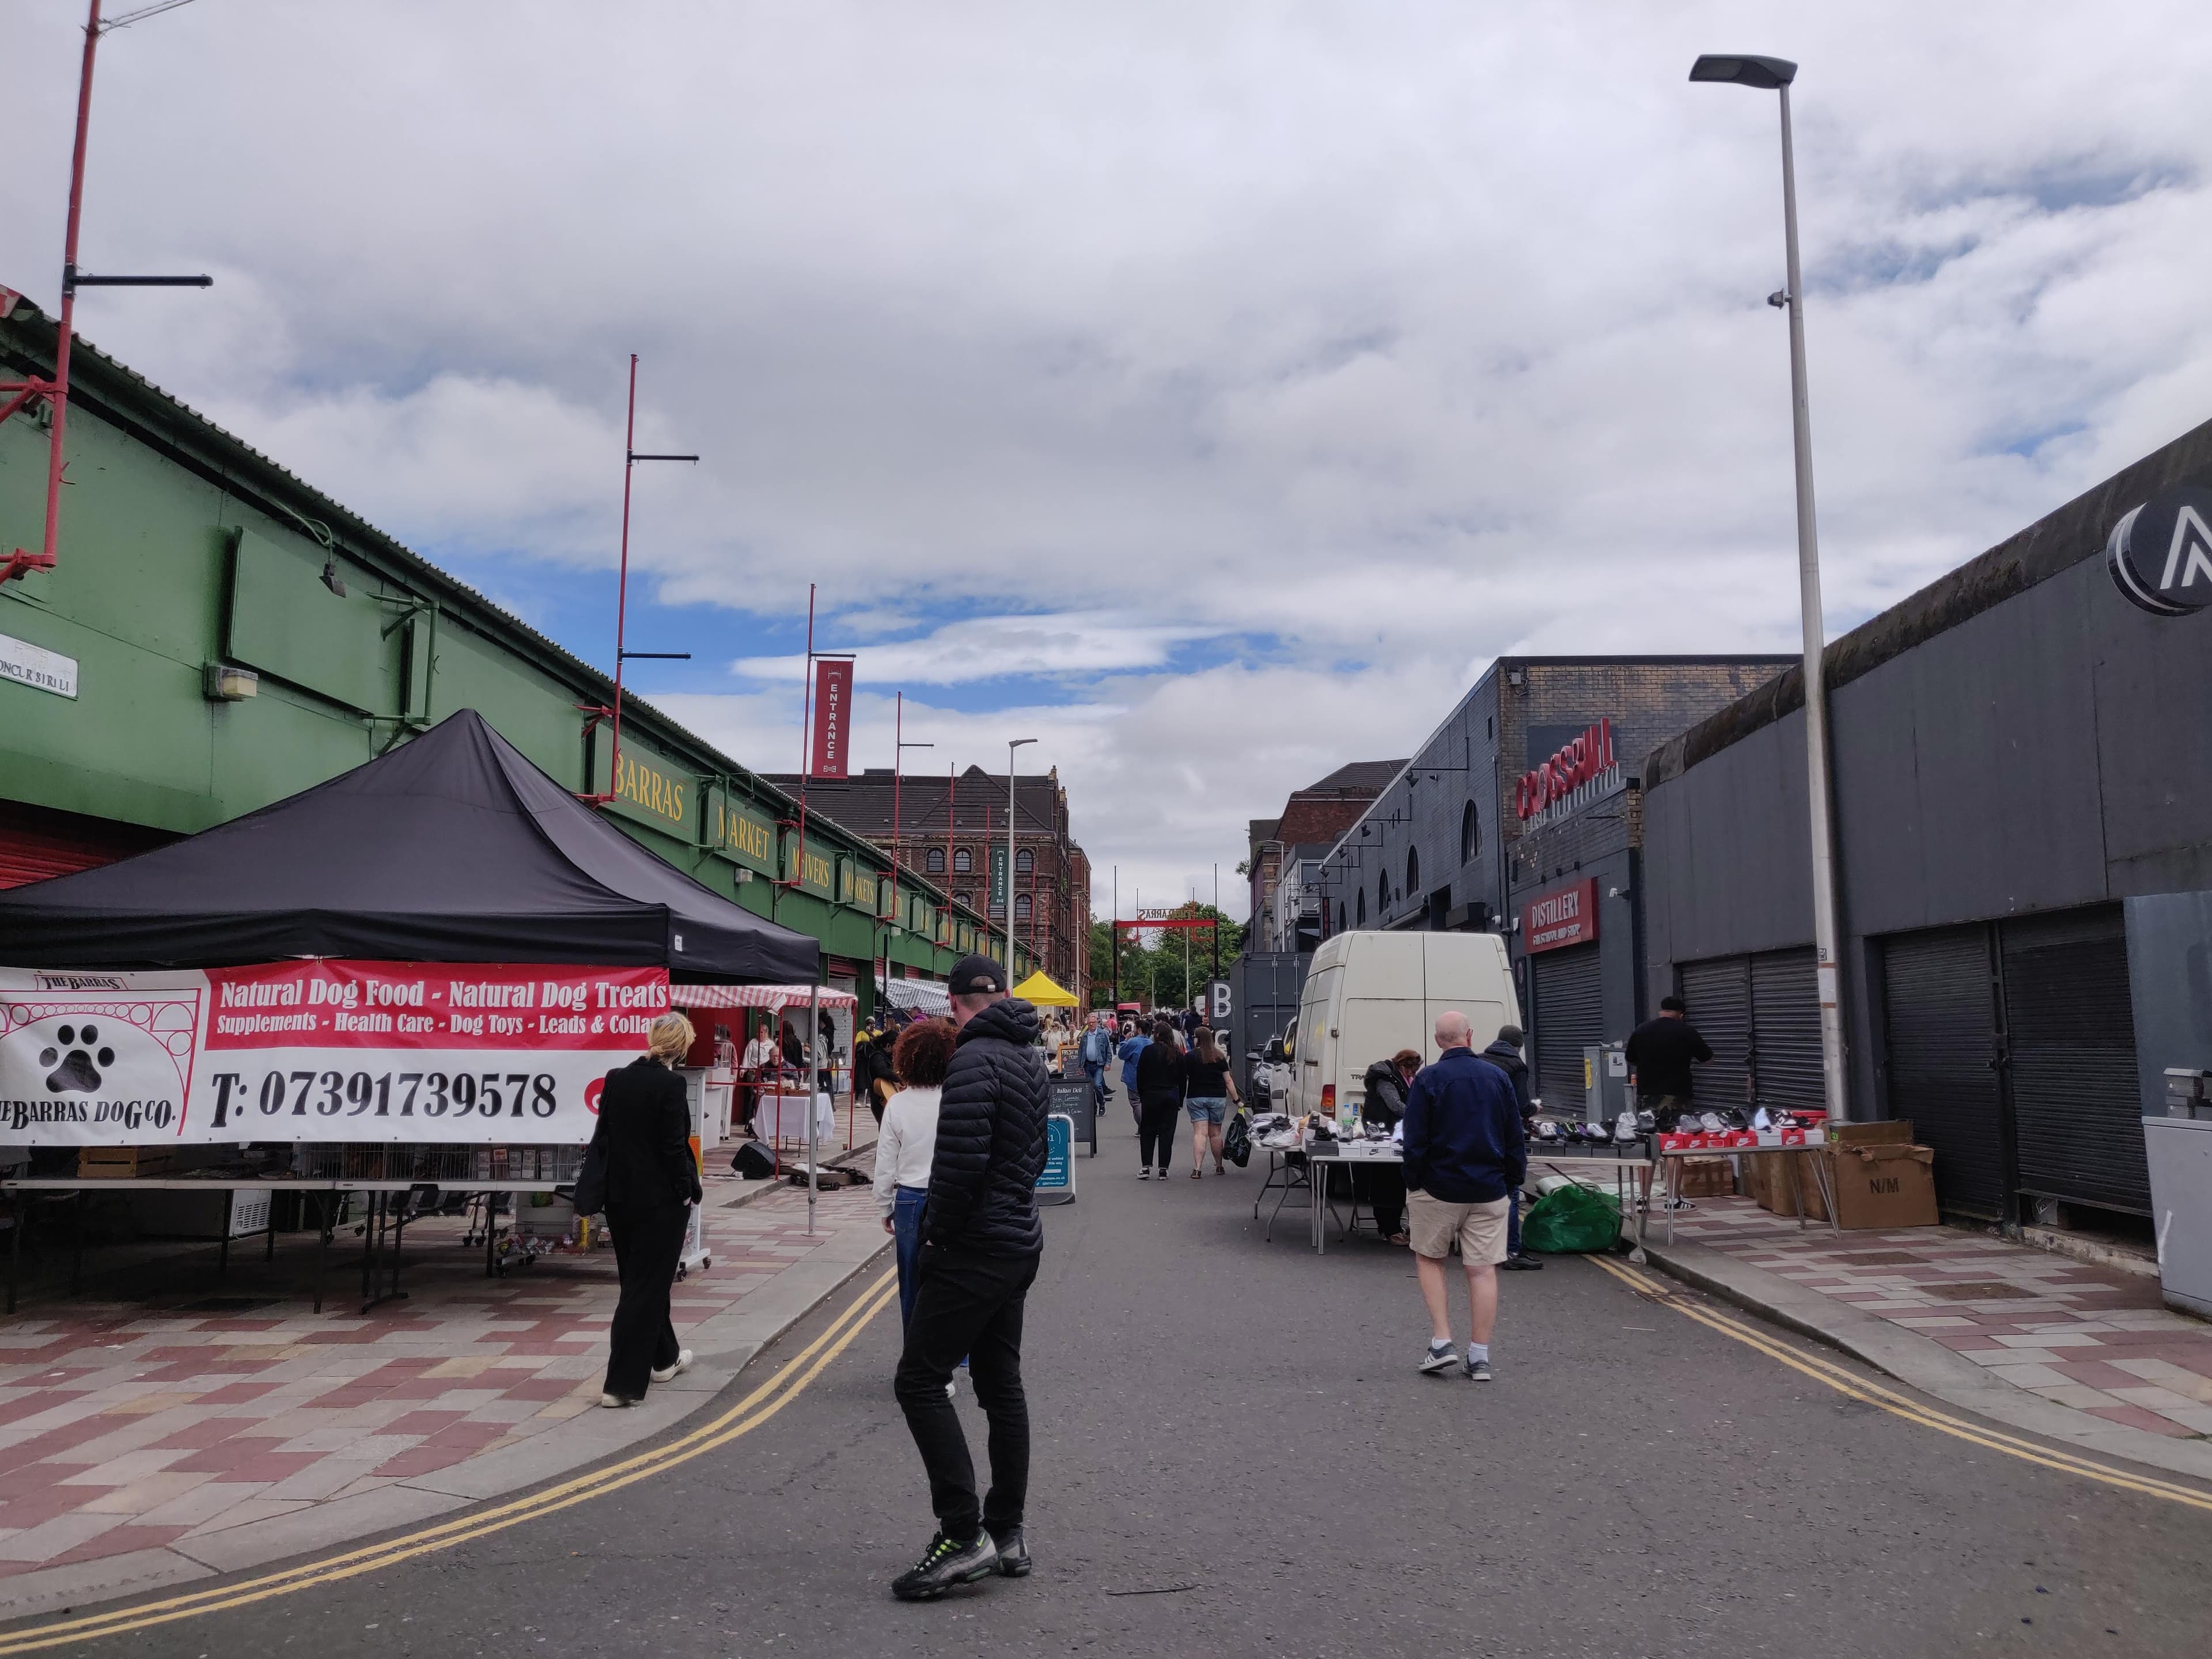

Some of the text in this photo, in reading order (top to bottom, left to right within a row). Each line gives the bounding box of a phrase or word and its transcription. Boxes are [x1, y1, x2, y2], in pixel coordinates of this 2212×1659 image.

[827, 684, 838, 759] ENTRANCE
[616, 753, 683, 821] BARRAS
[1532, 891, 1578, 929] DISTILLERY
[41, 977, 120, 990] THE BARRAS
[221, 979, 301, 1007] Natural
[308, 979, 358, 1009] Dog
[366, 980, 424, 1007] Food
[449, 982, 535, 1008] Natural
[540, 982, 587, 1011] Dog
[595, 982, 666, 1008] Treats
[217, 1013, 316, 1035] Supplements
[335, 1013, 391, 1032] Health
[397, 1013, 433, 1032] Care
[450, 1014, 483, 1035] Dog
[486, 1015, 523, 1035] Toys
[539, 1016, 586, 1034] Leads
[590, 1016, 604, 1034] &
[10, 1101, 89, 1130] BARRAS
[211, 1071, 556, 1128] T: 07391739578
[1870, 1177, 1899, 1194] N/M
